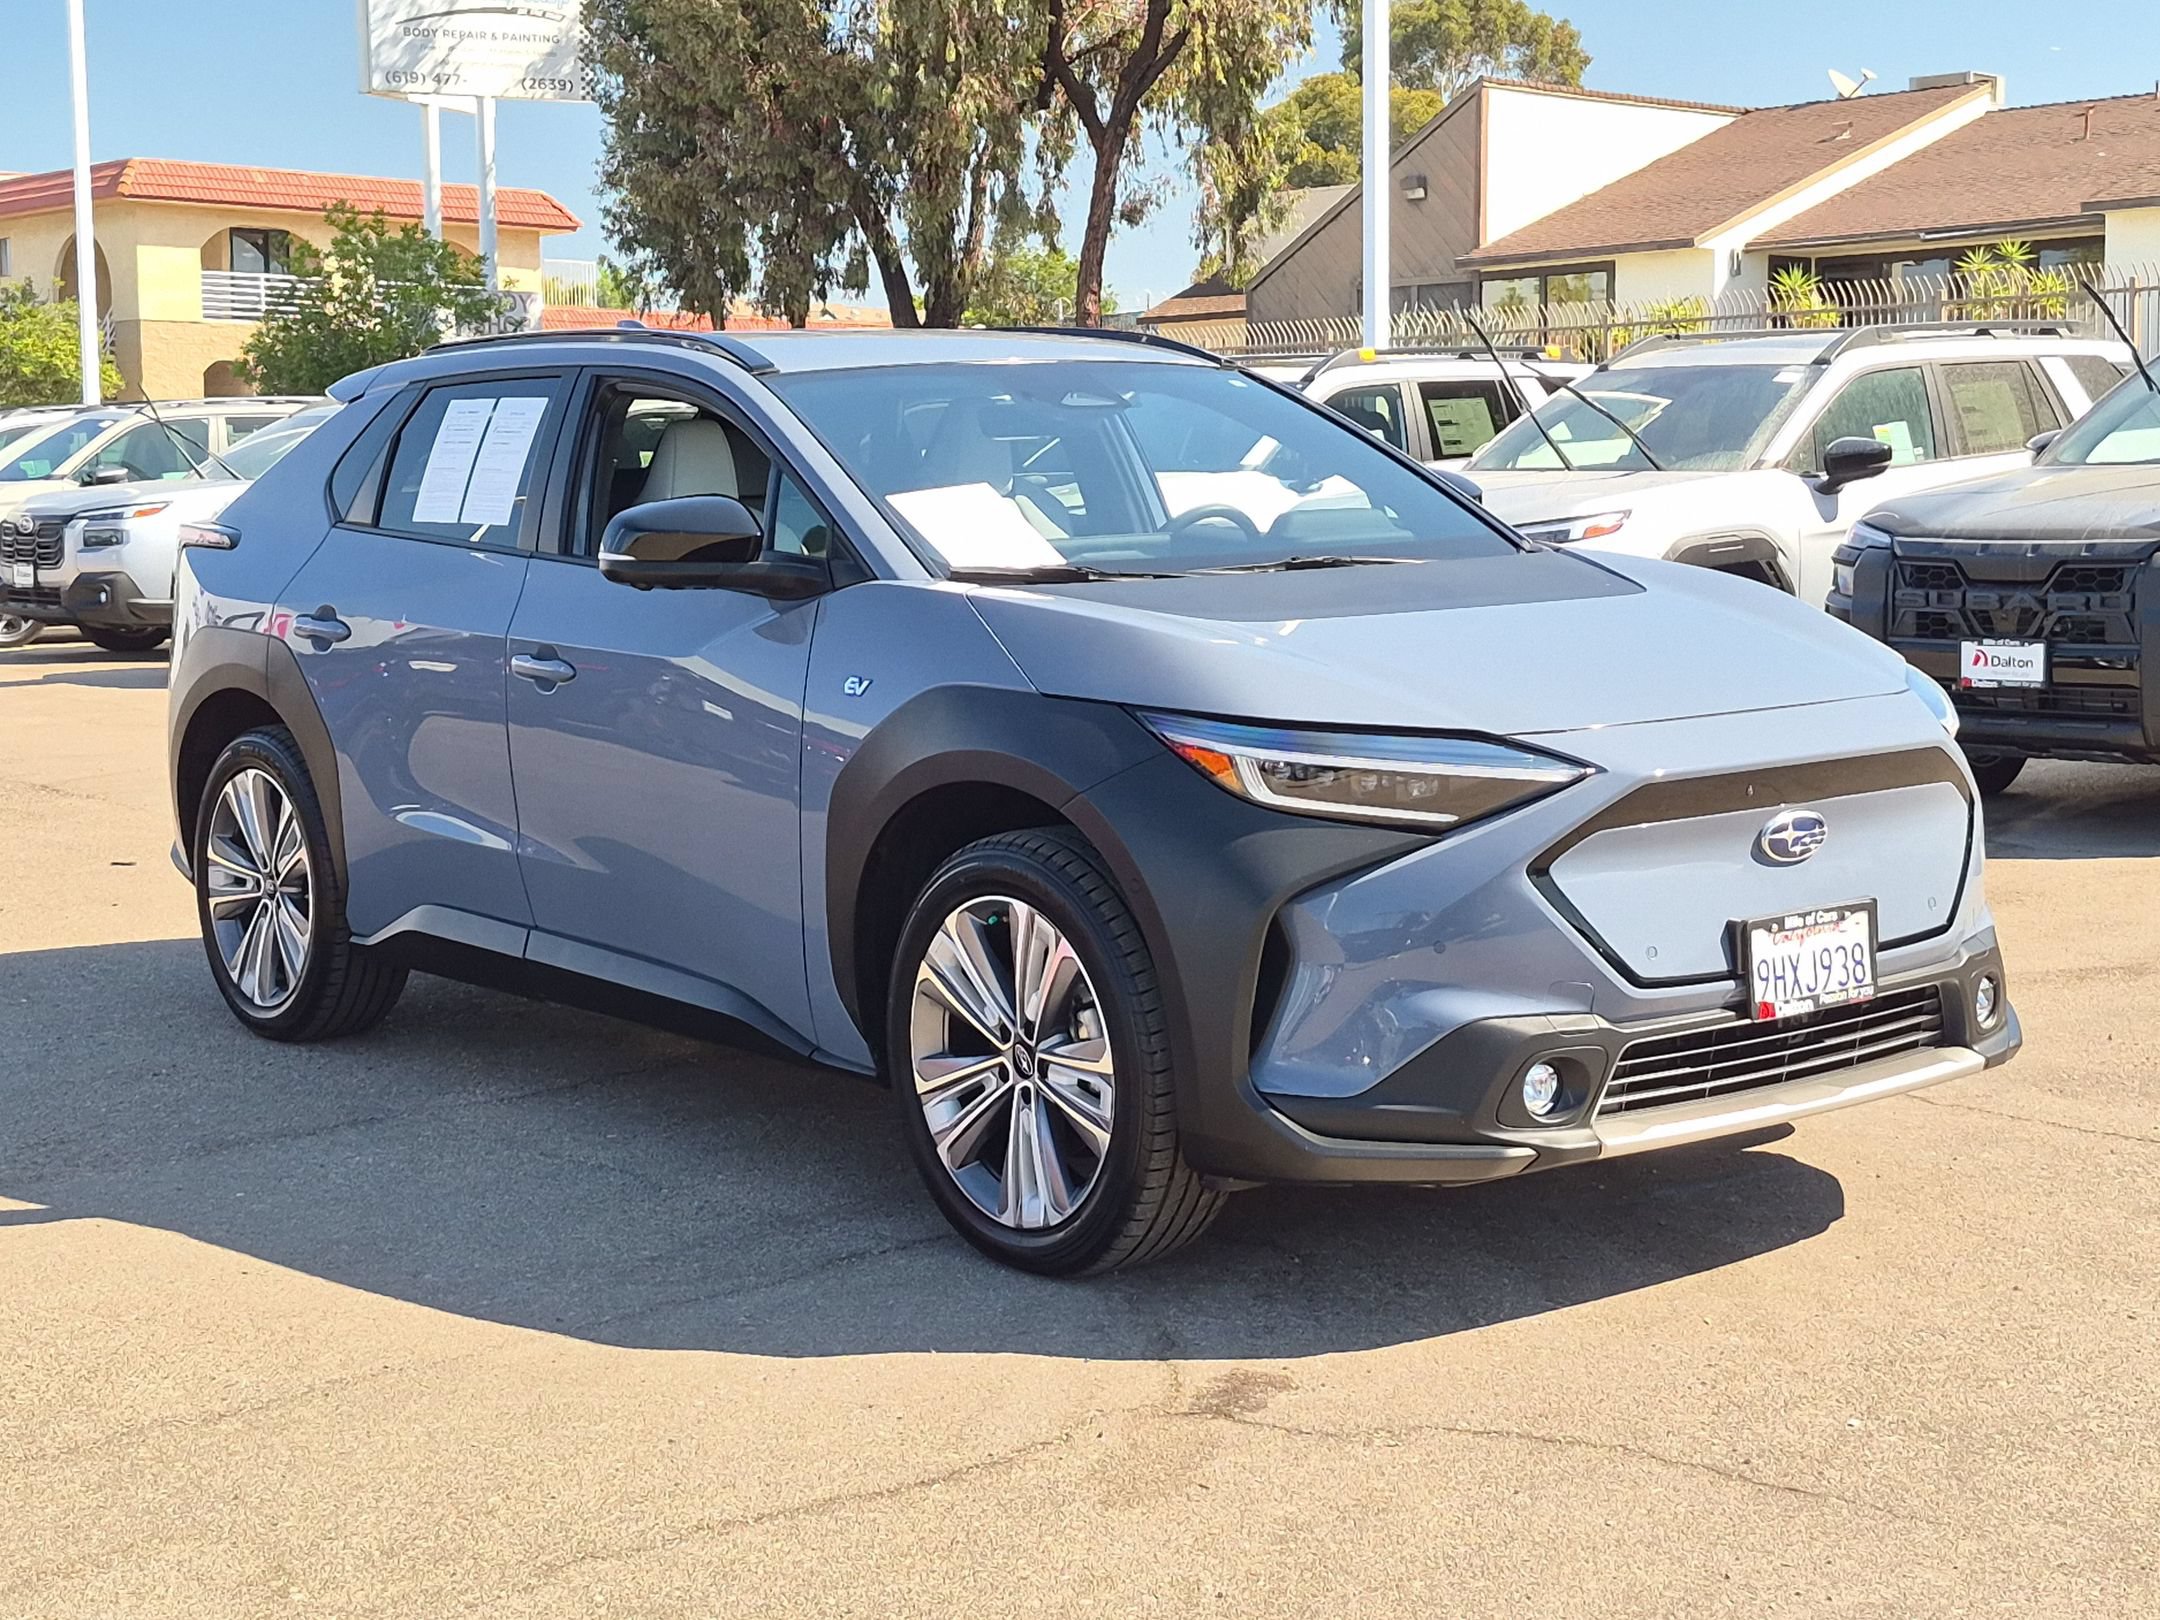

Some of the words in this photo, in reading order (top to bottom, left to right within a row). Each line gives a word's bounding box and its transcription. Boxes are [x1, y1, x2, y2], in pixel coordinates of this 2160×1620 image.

[403, 27, 438, 38] BODY
[443, 29, 486, 40] REPAIR
[491, 32, 498, 41] &
[502, 32, 560, 44] PAINTING
[385, 70, 426, 86] (619)
[521, 77, 574, 93] (2639)
[1894, 588, 2132, 613] SUBARU
[1990, 655, 2034, 669] Dalton
[844, 676, 872, 696] EV
[1757, 942, 1867, 1000] 9HXJ938
